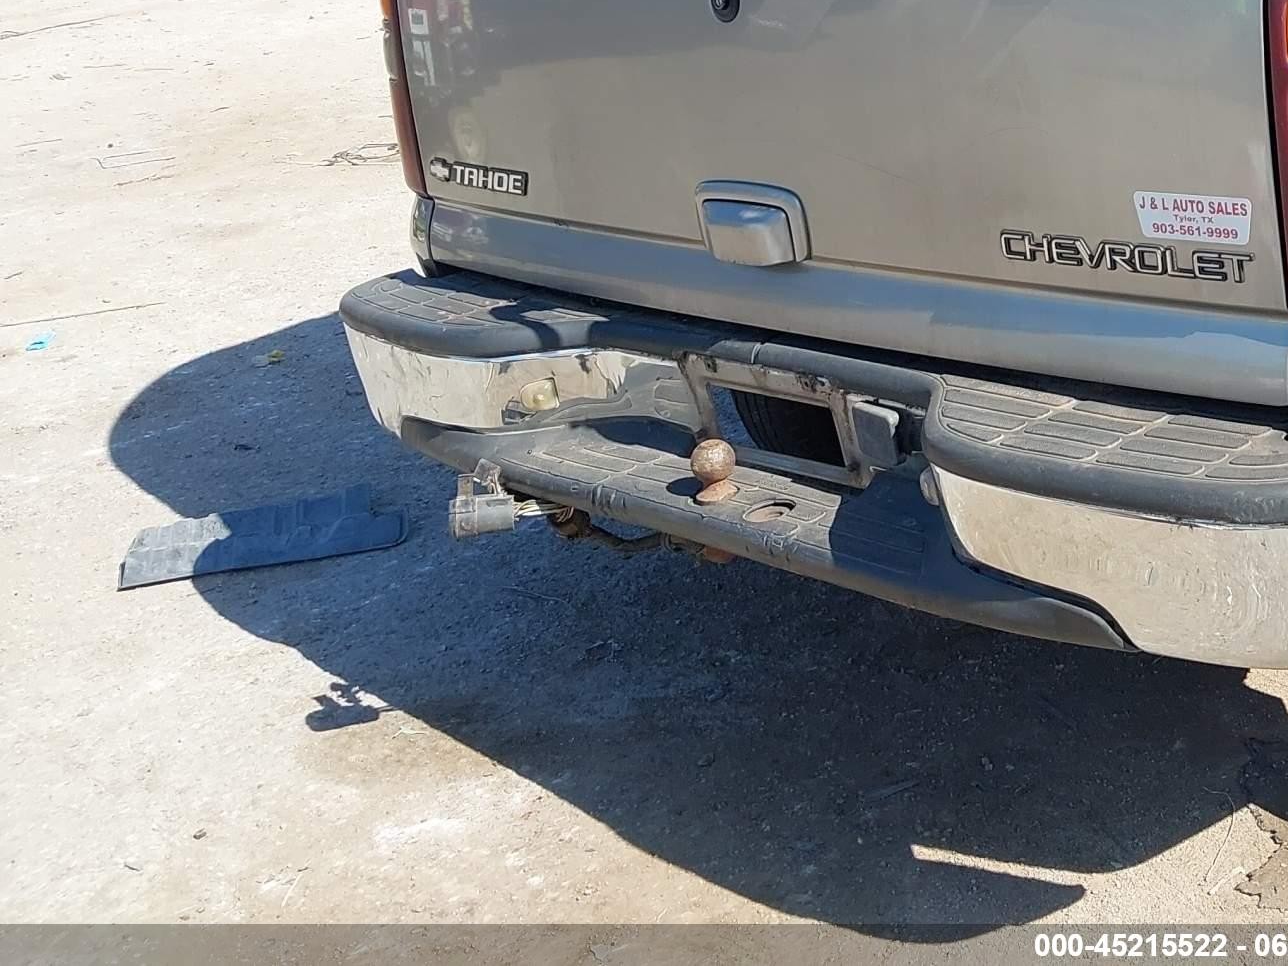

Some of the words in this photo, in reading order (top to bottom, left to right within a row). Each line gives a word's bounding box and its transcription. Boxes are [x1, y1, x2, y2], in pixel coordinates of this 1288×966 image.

[453, 161, 528, 196] TAHOE
[1139, 196, 1146, 210] J
[1150, 196, 1159, 210] &
[1161, 197, 1169, 211] L
[1172, 198, 1205, 214] AUTO
[1208, 201, 1248, 217] SALES
[1173, 214, 1199, 224] Tyler,
[1201, 216, 1215, 224] TX
[1152, 222, 1239, 239] 903-561-9999
[1000, 229, 1255, 284] CHEVROLET
